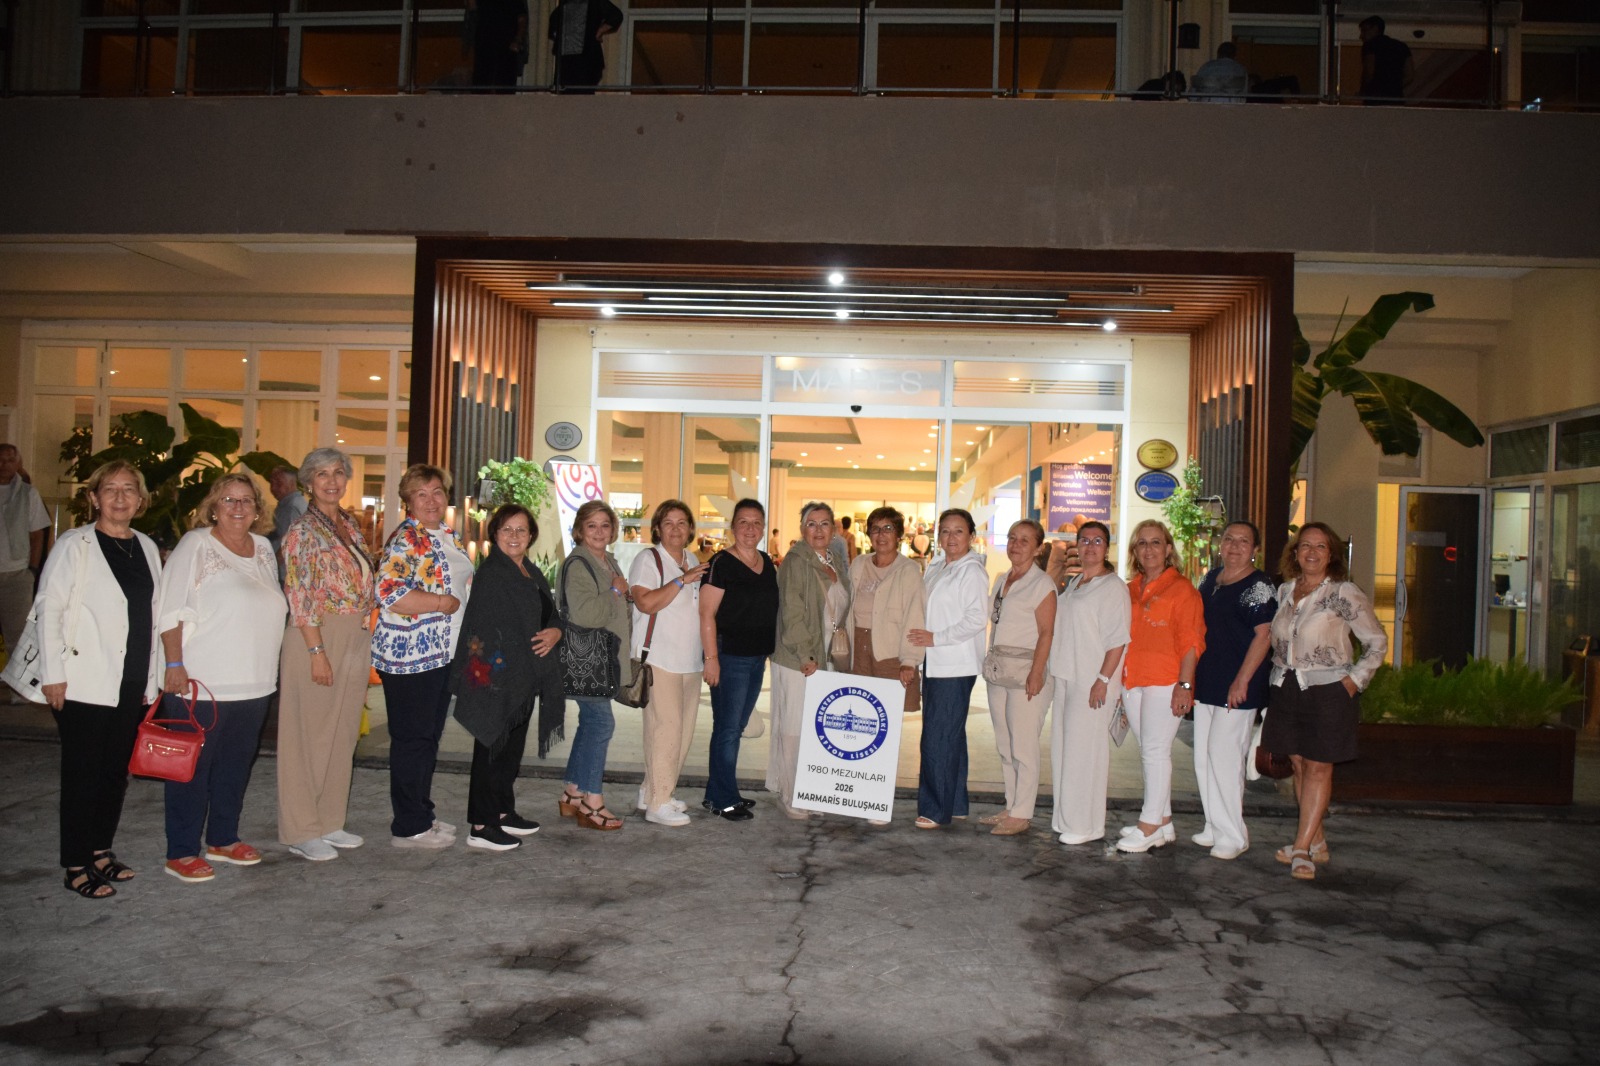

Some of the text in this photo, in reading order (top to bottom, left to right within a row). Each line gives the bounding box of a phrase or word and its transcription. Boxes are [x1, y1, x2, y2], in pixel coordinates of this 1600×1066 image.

[792, 368, 922, 394] MARES
[1074, 471, 1112, 480] Welcome
[819, 735, 878, 759] AFYON LİSESİ
[807, 764, 886, 783] 1980 MEZUNLARI
[834, 782, 854, 793] 2026
[797, 791, 889, 813] MARMARİS BULUŞMASI
